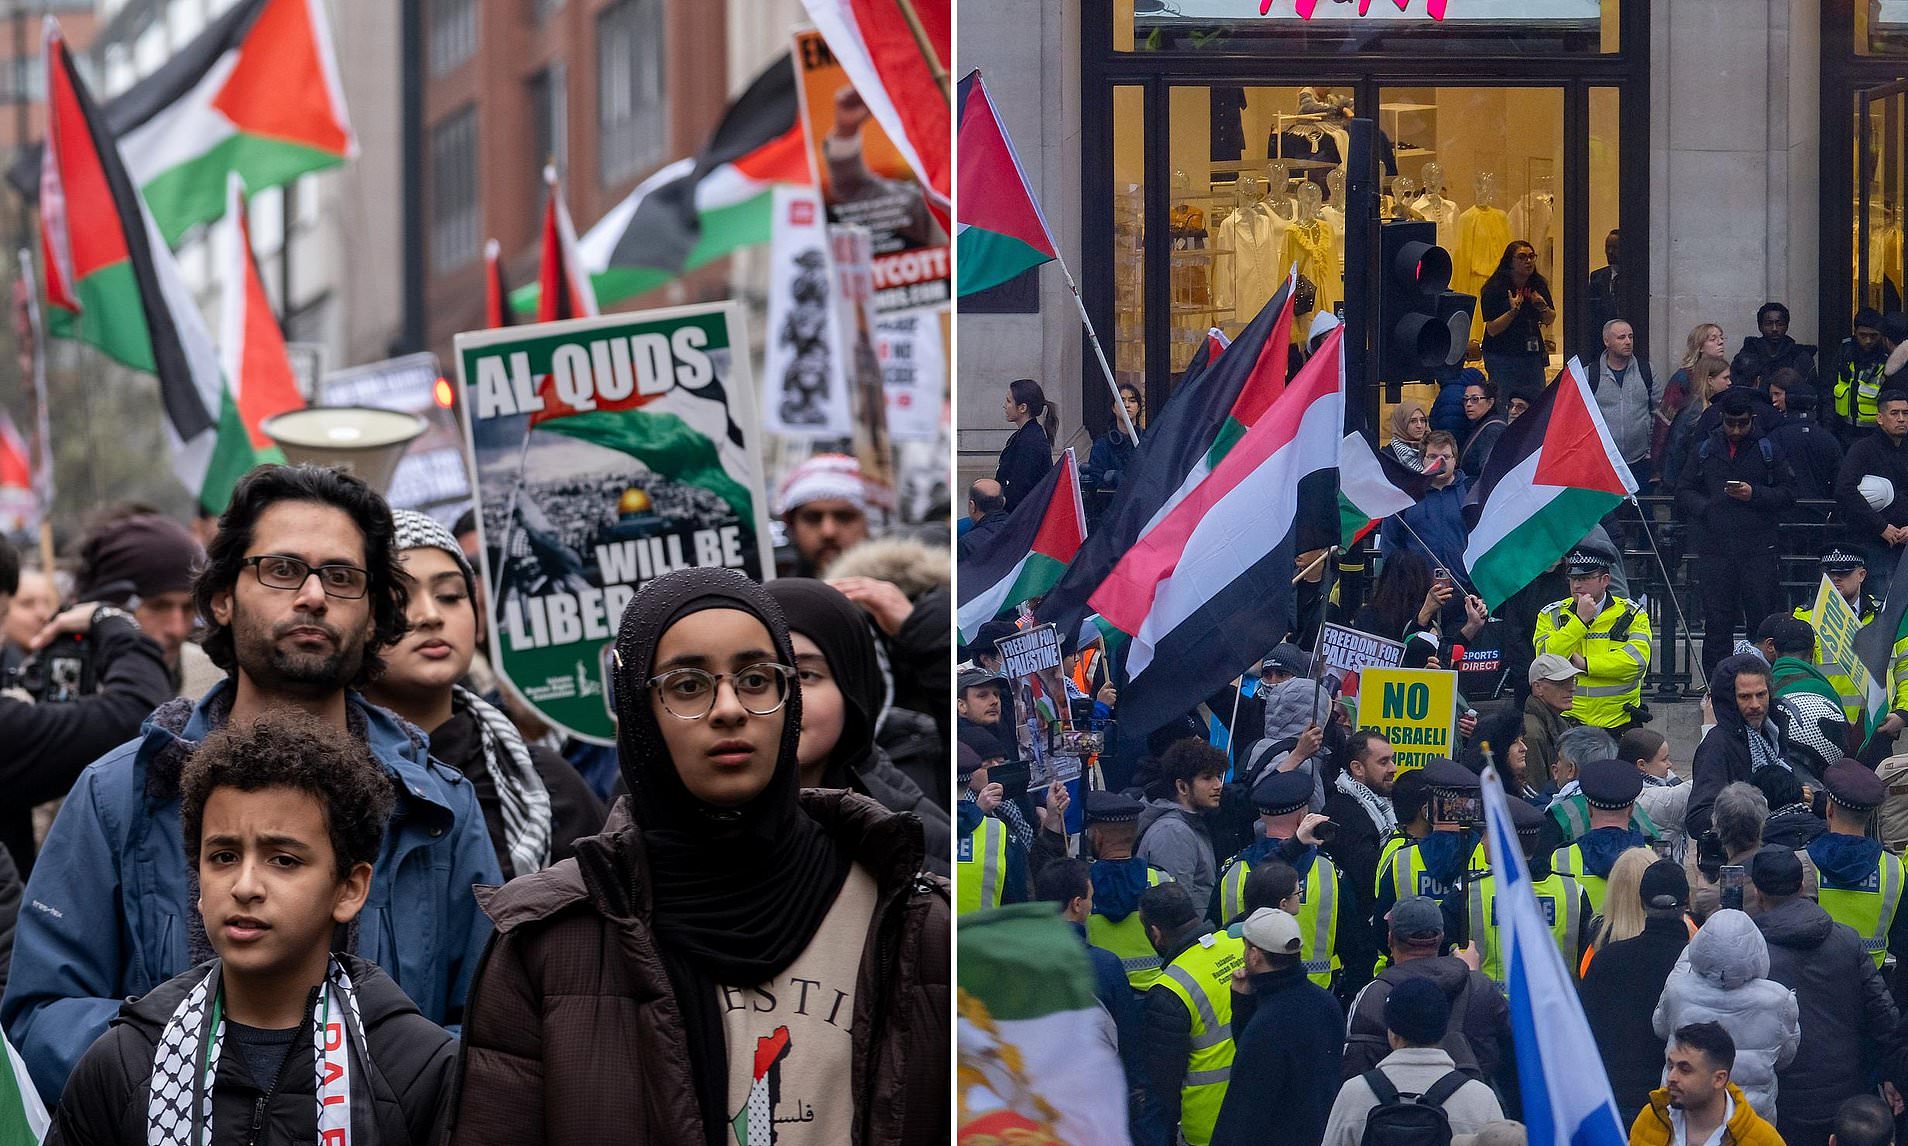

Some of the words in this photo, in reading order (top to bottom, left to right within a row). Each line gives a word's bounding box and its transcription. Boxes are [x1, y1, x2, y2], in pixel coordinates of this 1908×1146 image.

[476, 351, 545, 420] AL
[552, 325, 714, 412] QUDS
[595, 533, 689, 585] WILL
[693, 525, 745, 569] BE
[507, 582, 640, 652] LIBER
[1820, 589, 1847, 654] STOP
[1000, 631, 1041, 659] FREEDOM
[1038, 628, 1056, 648] FOR
[1005, 643, 1060, 680] PALESTINE
[1323, 627, 1378, 657] FREEDOM
[1378, 643, 1400, 664] FOR
[1462, 650, 1499, 660] SPORTS
[1462, 661, 1499, 671] DIRECT
[1382, 682, 1430, 721] NO
[1385, 726, 1447, 746] ISRAELI
[321, 1022, 347, 1146] PALE
